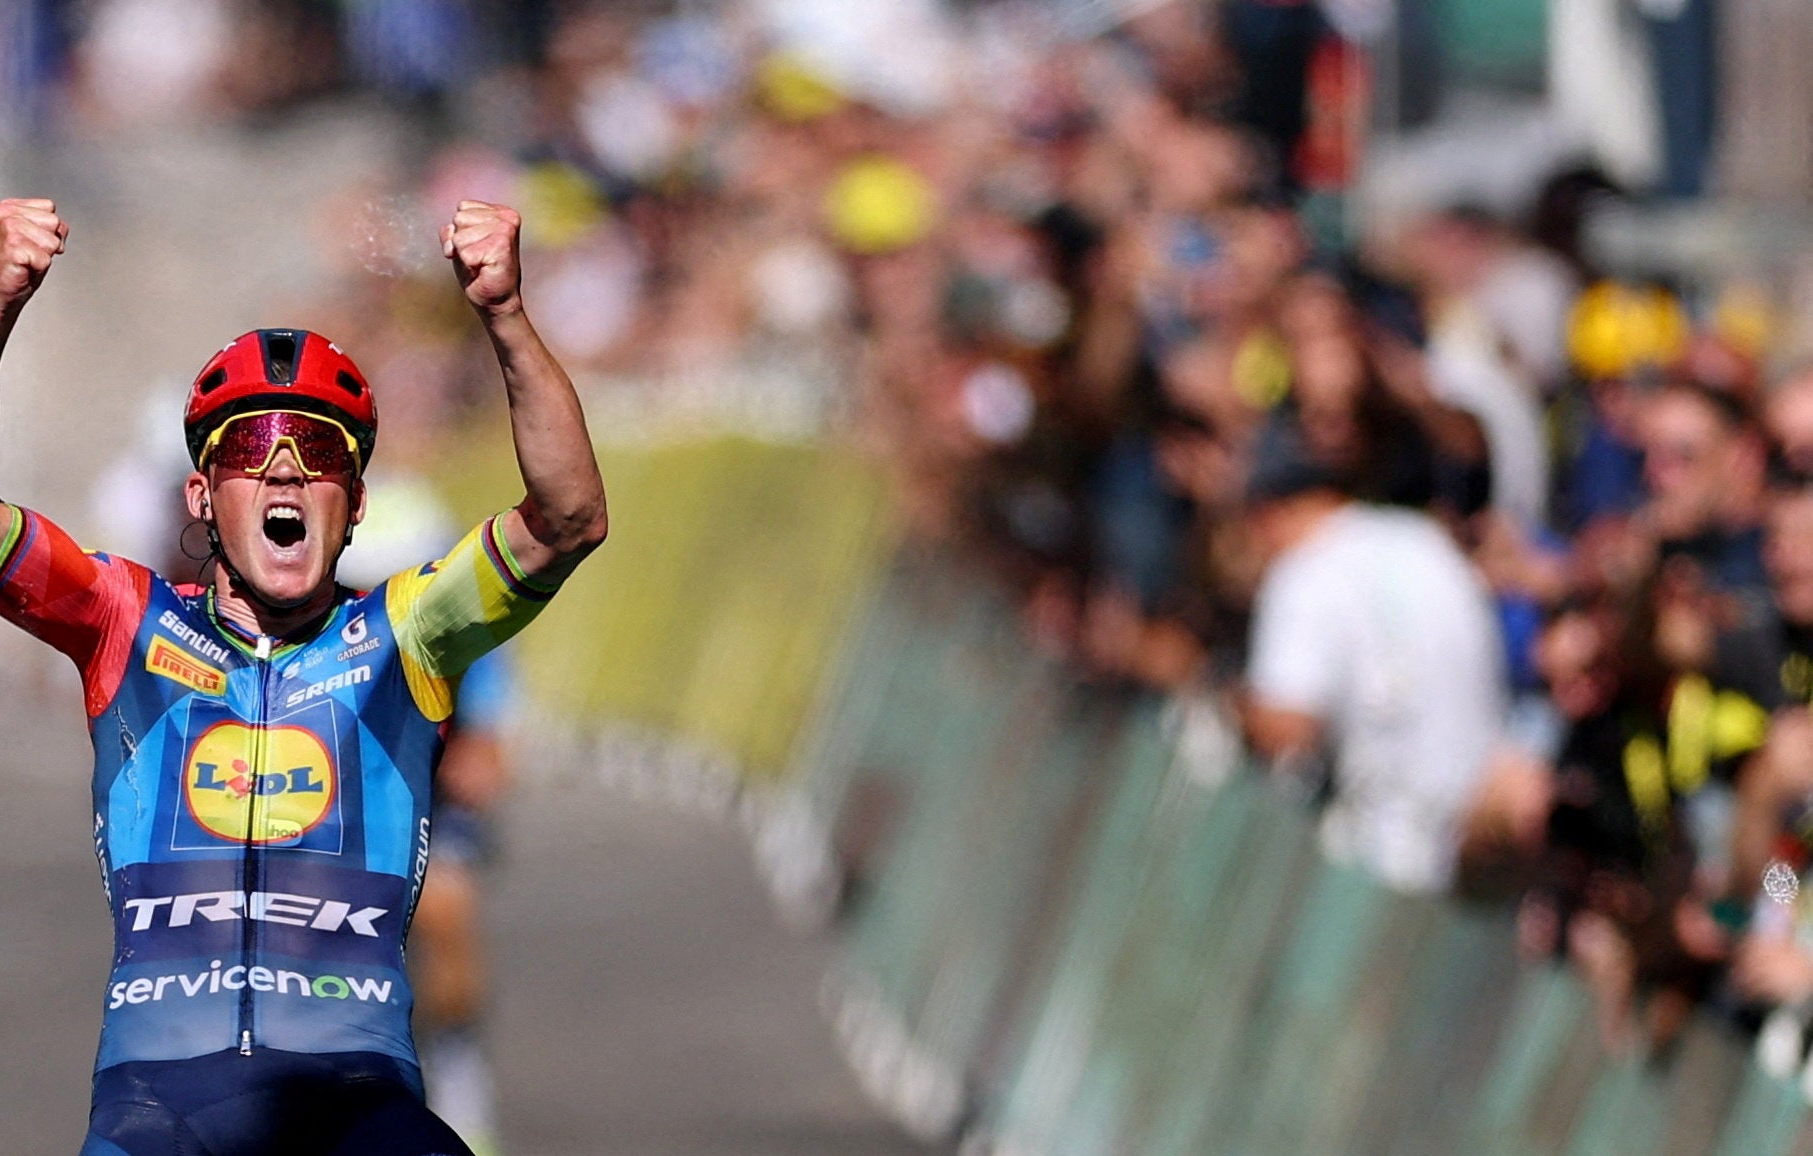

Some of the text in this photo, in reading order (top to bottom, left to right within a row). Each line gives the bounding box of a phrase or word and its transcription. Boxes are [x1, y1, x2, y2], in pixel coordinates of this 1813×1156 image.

[159, 610, 229, 664] Santini
[337, 637, 381, 662] GATORADE
[152, 645, 219, 692] PIRELLI
[286, 665, 372, 708] SRAM
[125, 890, 389, 938] TREK
[109, 959, 392, 1010] servicenow
